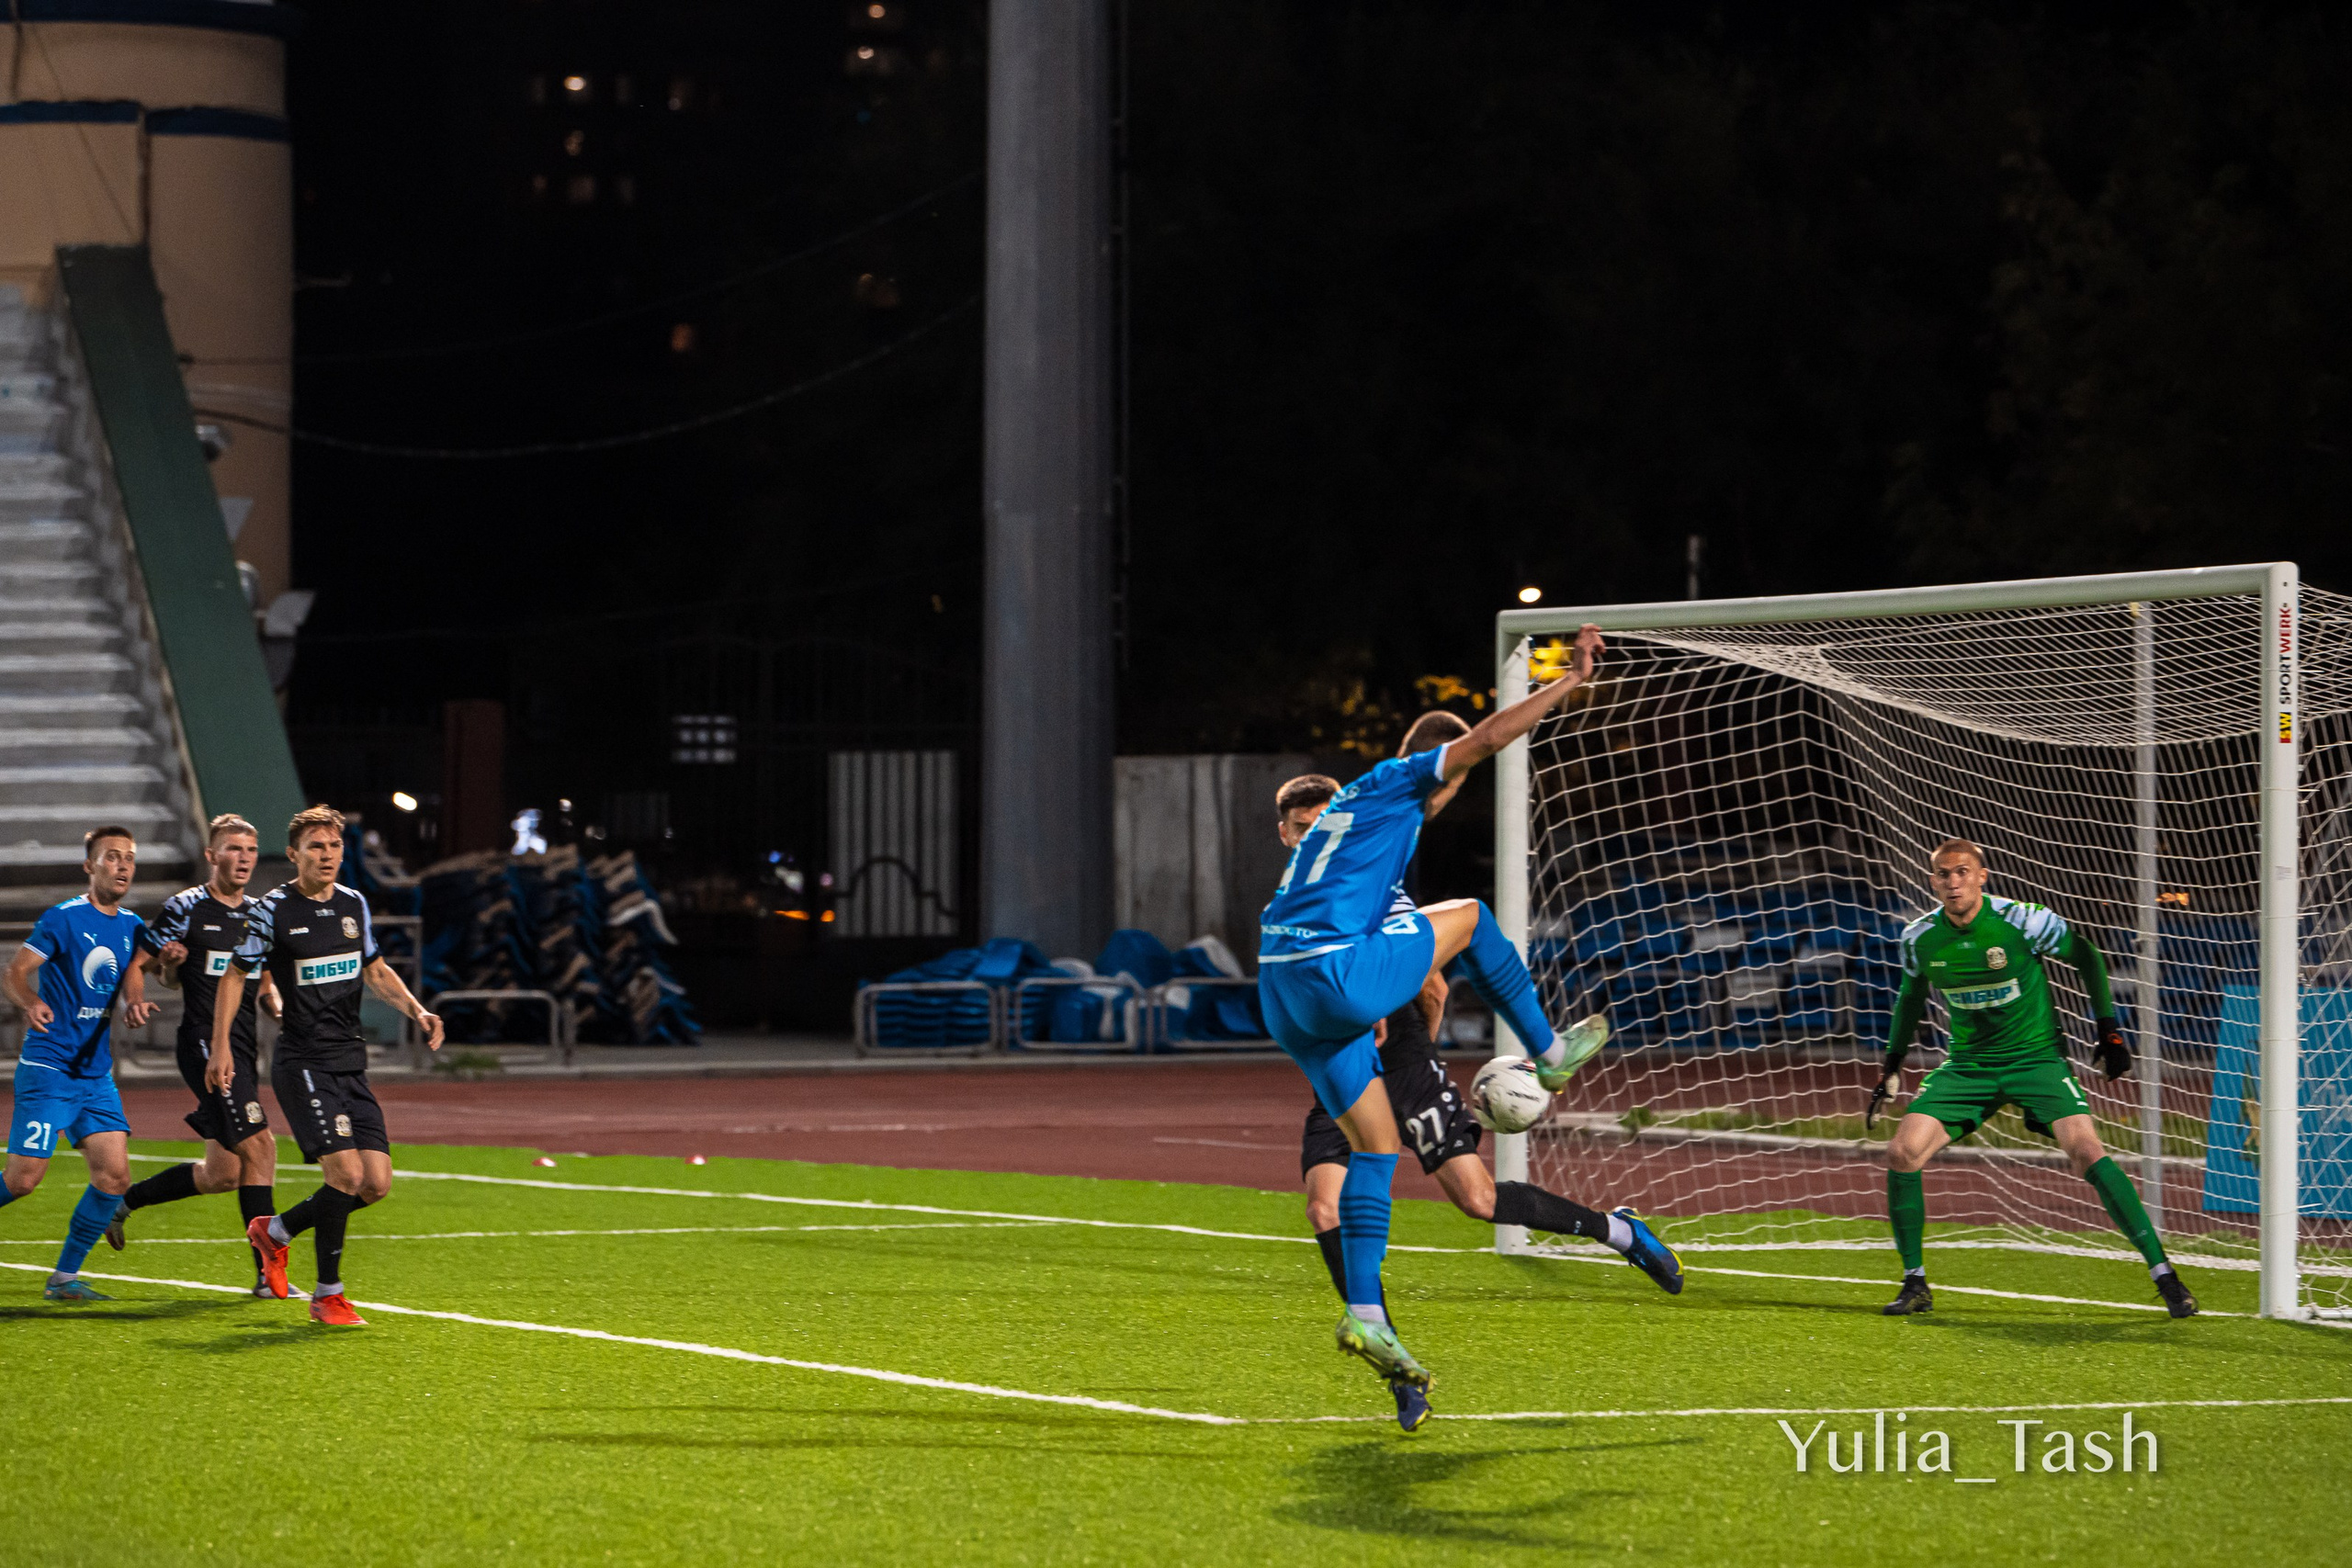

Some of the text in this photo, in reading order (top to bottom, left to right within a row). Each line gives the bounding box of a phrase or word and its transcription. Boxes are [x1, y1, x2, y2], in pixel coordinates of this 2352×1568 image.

[2278, 607, 2292, 705] SPORTWERK
[301, 958, 357, 981] СИБУР
[1948, 986, 2012, 1005] СИБУР
[2061, 1077, 2082, 1099] 1
[23, 1120, 51, 1151] 21
[1406, 1107, 1446, 1156] 27
